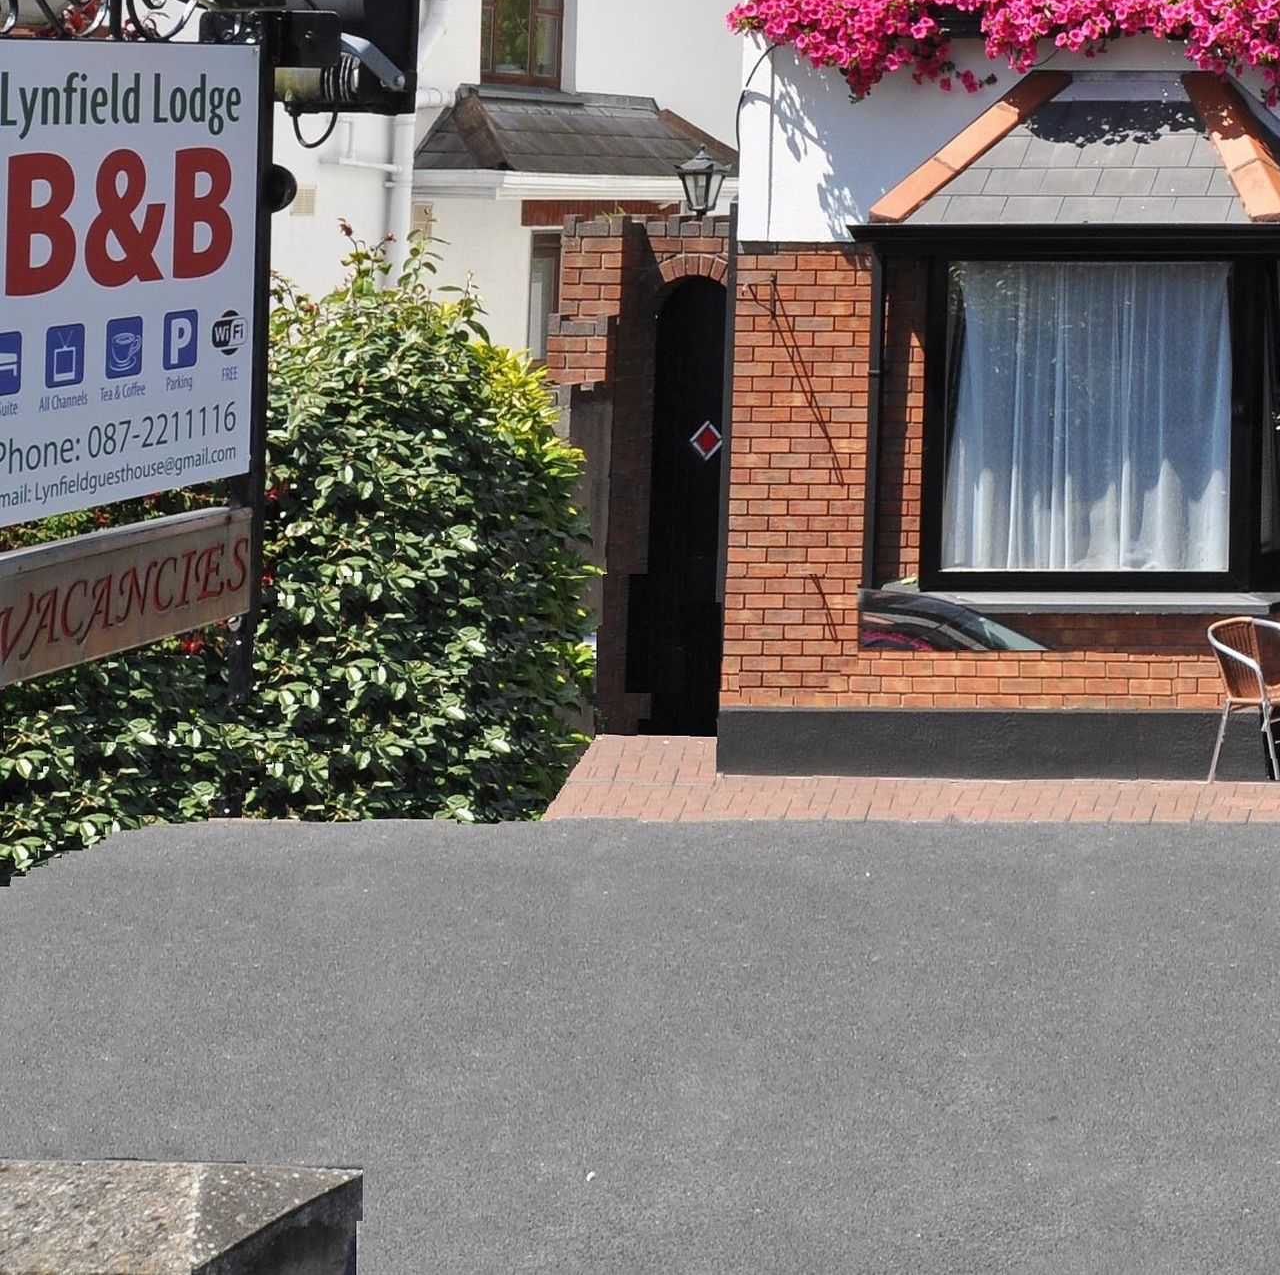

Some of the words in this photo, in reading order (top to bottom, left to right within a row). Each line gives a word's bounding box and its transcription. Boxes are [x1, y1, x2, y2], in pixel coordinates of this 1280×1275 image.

[0, 71, 141, 140] Lynfield
[153, 72, 242, 136] Lodge
[4, 146, 235, 297] B&B
[38, 396, 50, 413] All
[51, 391, 89, 409] Channels
[100, 387, 113, 402] Tea
[114, 385, 121, 399] &
[122, 381, 146, 399] Coffee
[166, 375, 193, 392] Parking
[221, 366, 239, 382] FREE
[87, 401, 237, 459] 087-2211116
[35, 446, 237, 506] Lynfieldguesthouse@gmail.com
[0, 537, 249, 666] VACANCIES
